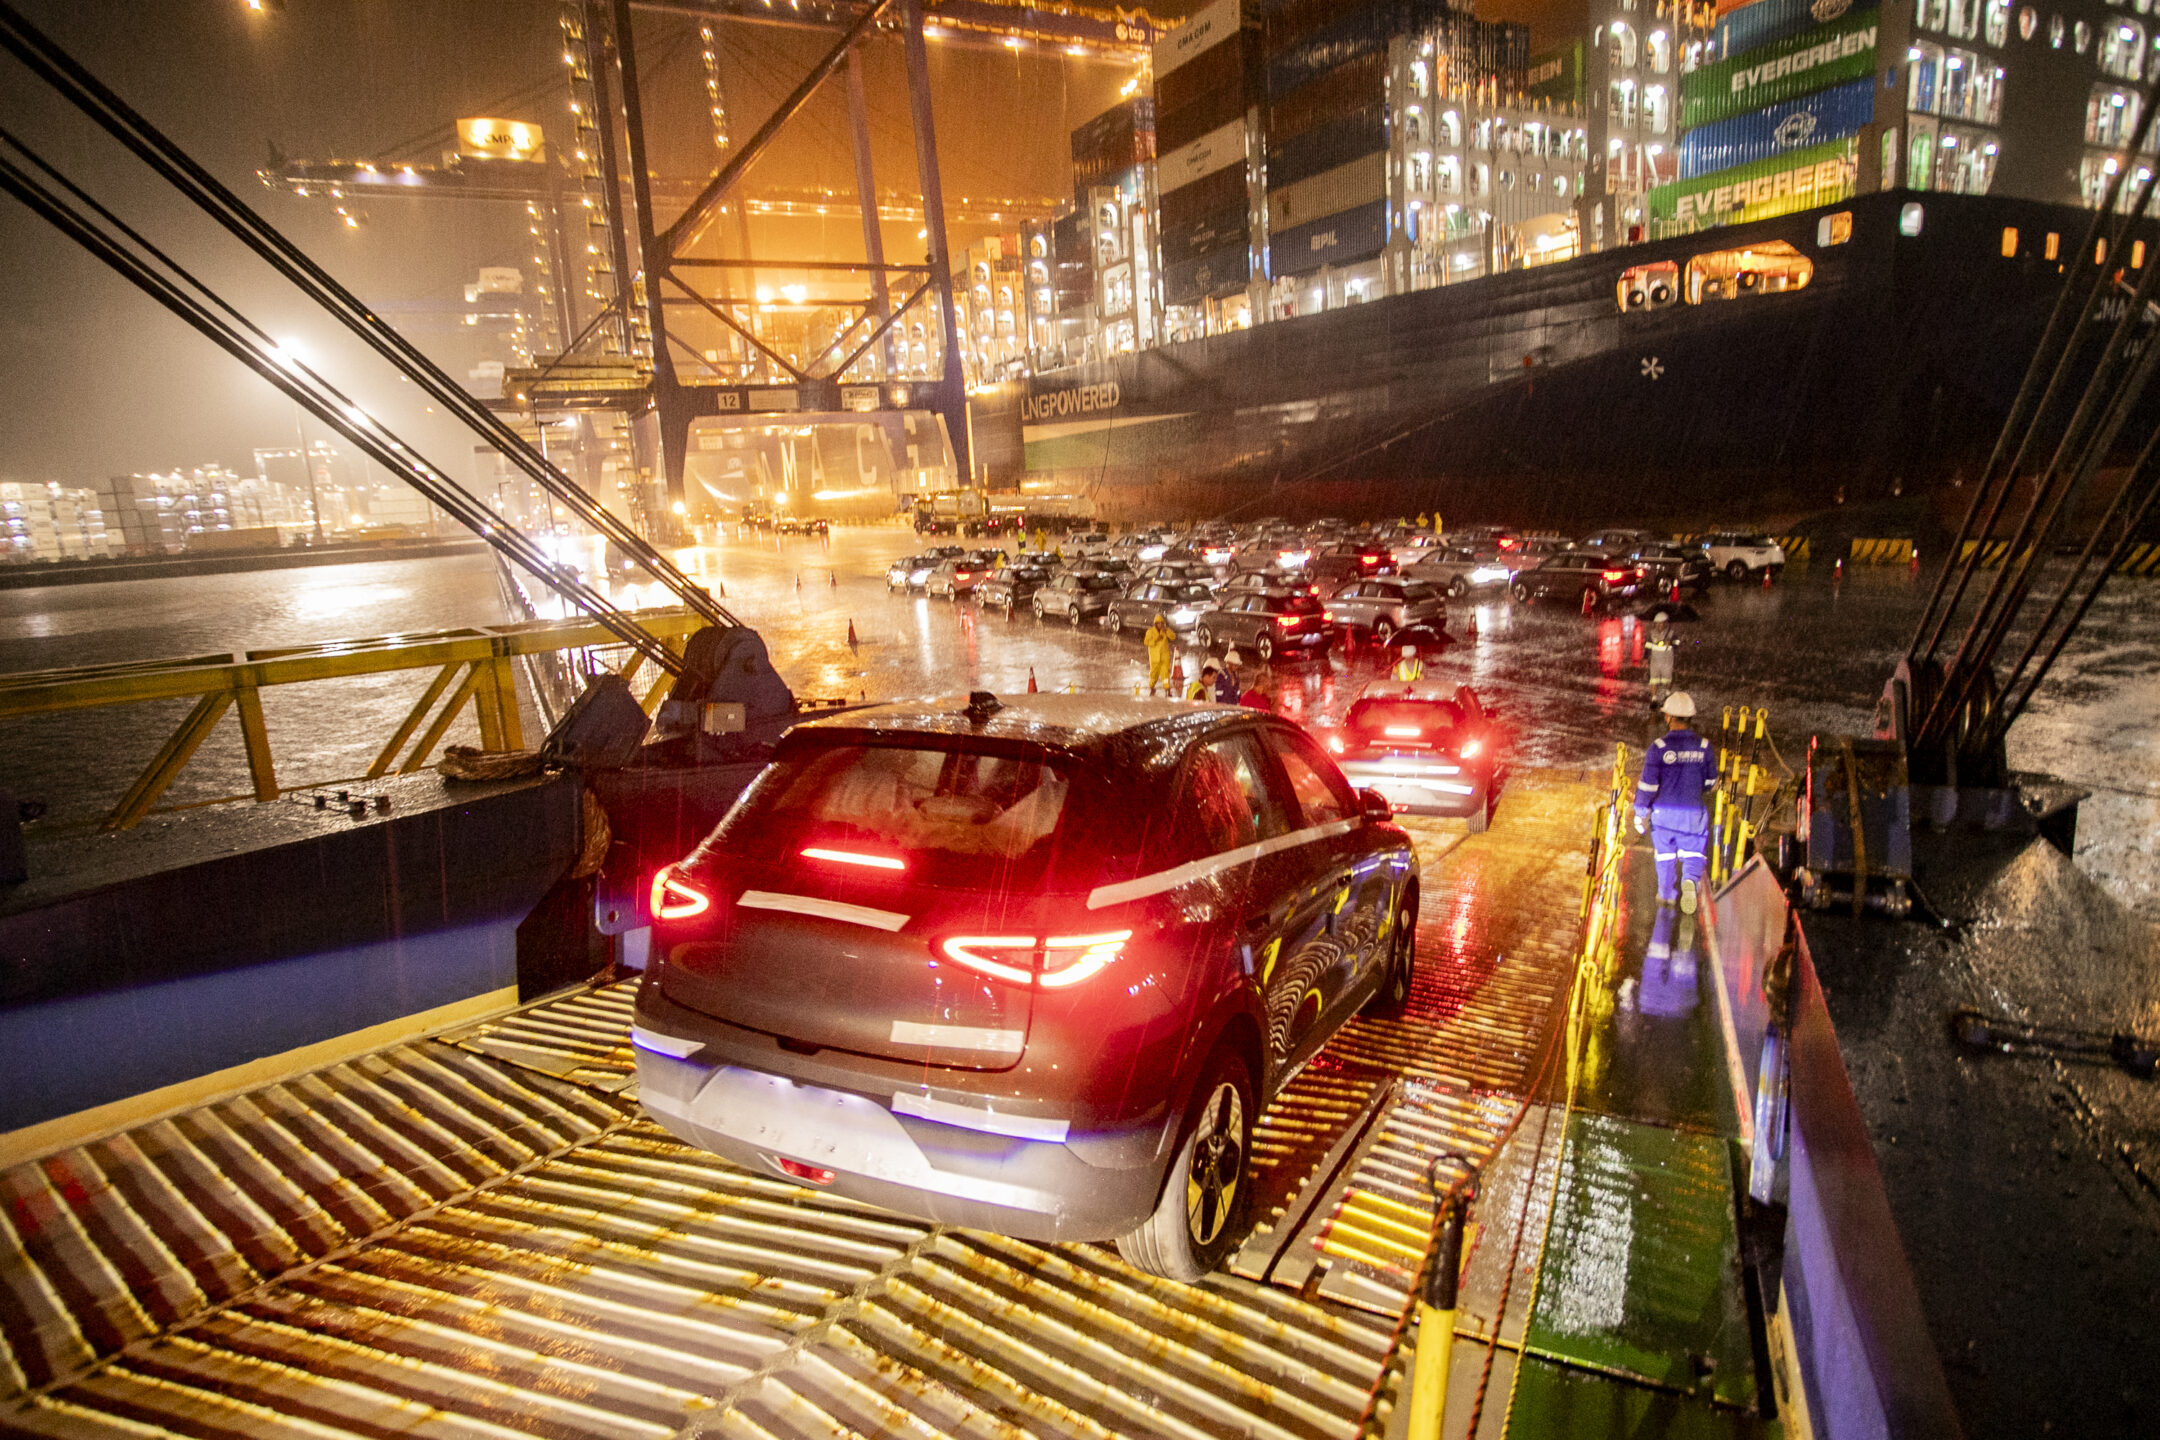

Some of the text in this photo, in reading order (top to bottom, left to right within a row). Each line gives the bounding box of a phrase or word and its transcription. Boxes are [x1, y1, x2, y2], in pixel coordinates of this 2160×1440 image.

[1128, 25, 1145, 44] tcp
[1177, 33, 1193, 49] CMA
[1194, 20, 1211, 39] CGM
[1731, 26, 1878, 93] EVERGREEN
[1676, 154, 1859, 221] EVERGREEN
[722, 395, 737, 407] 12
[1021, 381, 1120, 421] LNGPOWERED
